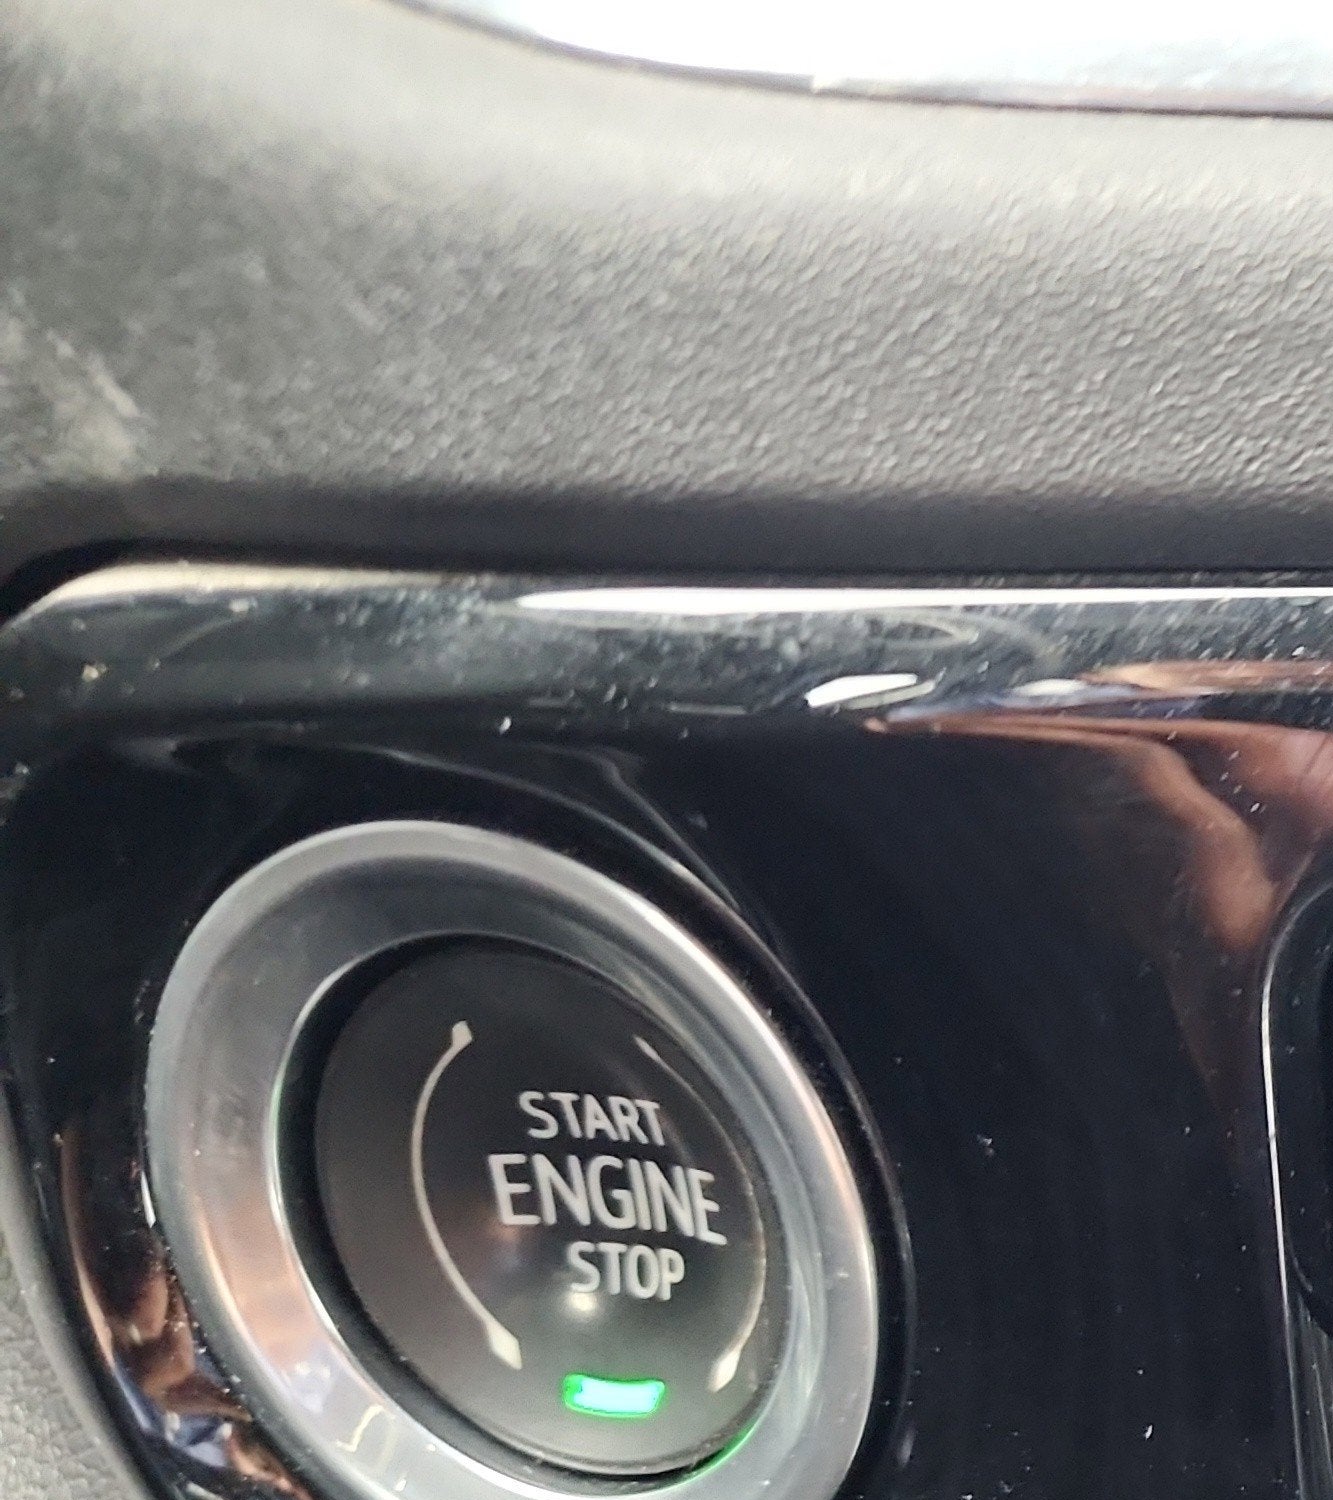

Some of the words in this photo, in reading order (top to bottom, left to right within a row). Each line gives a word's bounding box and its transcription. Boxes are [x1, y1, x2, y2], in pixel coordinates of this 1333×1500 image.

[519, 1090, 666, 1146] START
[487, 1153, 728, 1245] ENGINE
[567, 1241, 686, 1300] STOP
